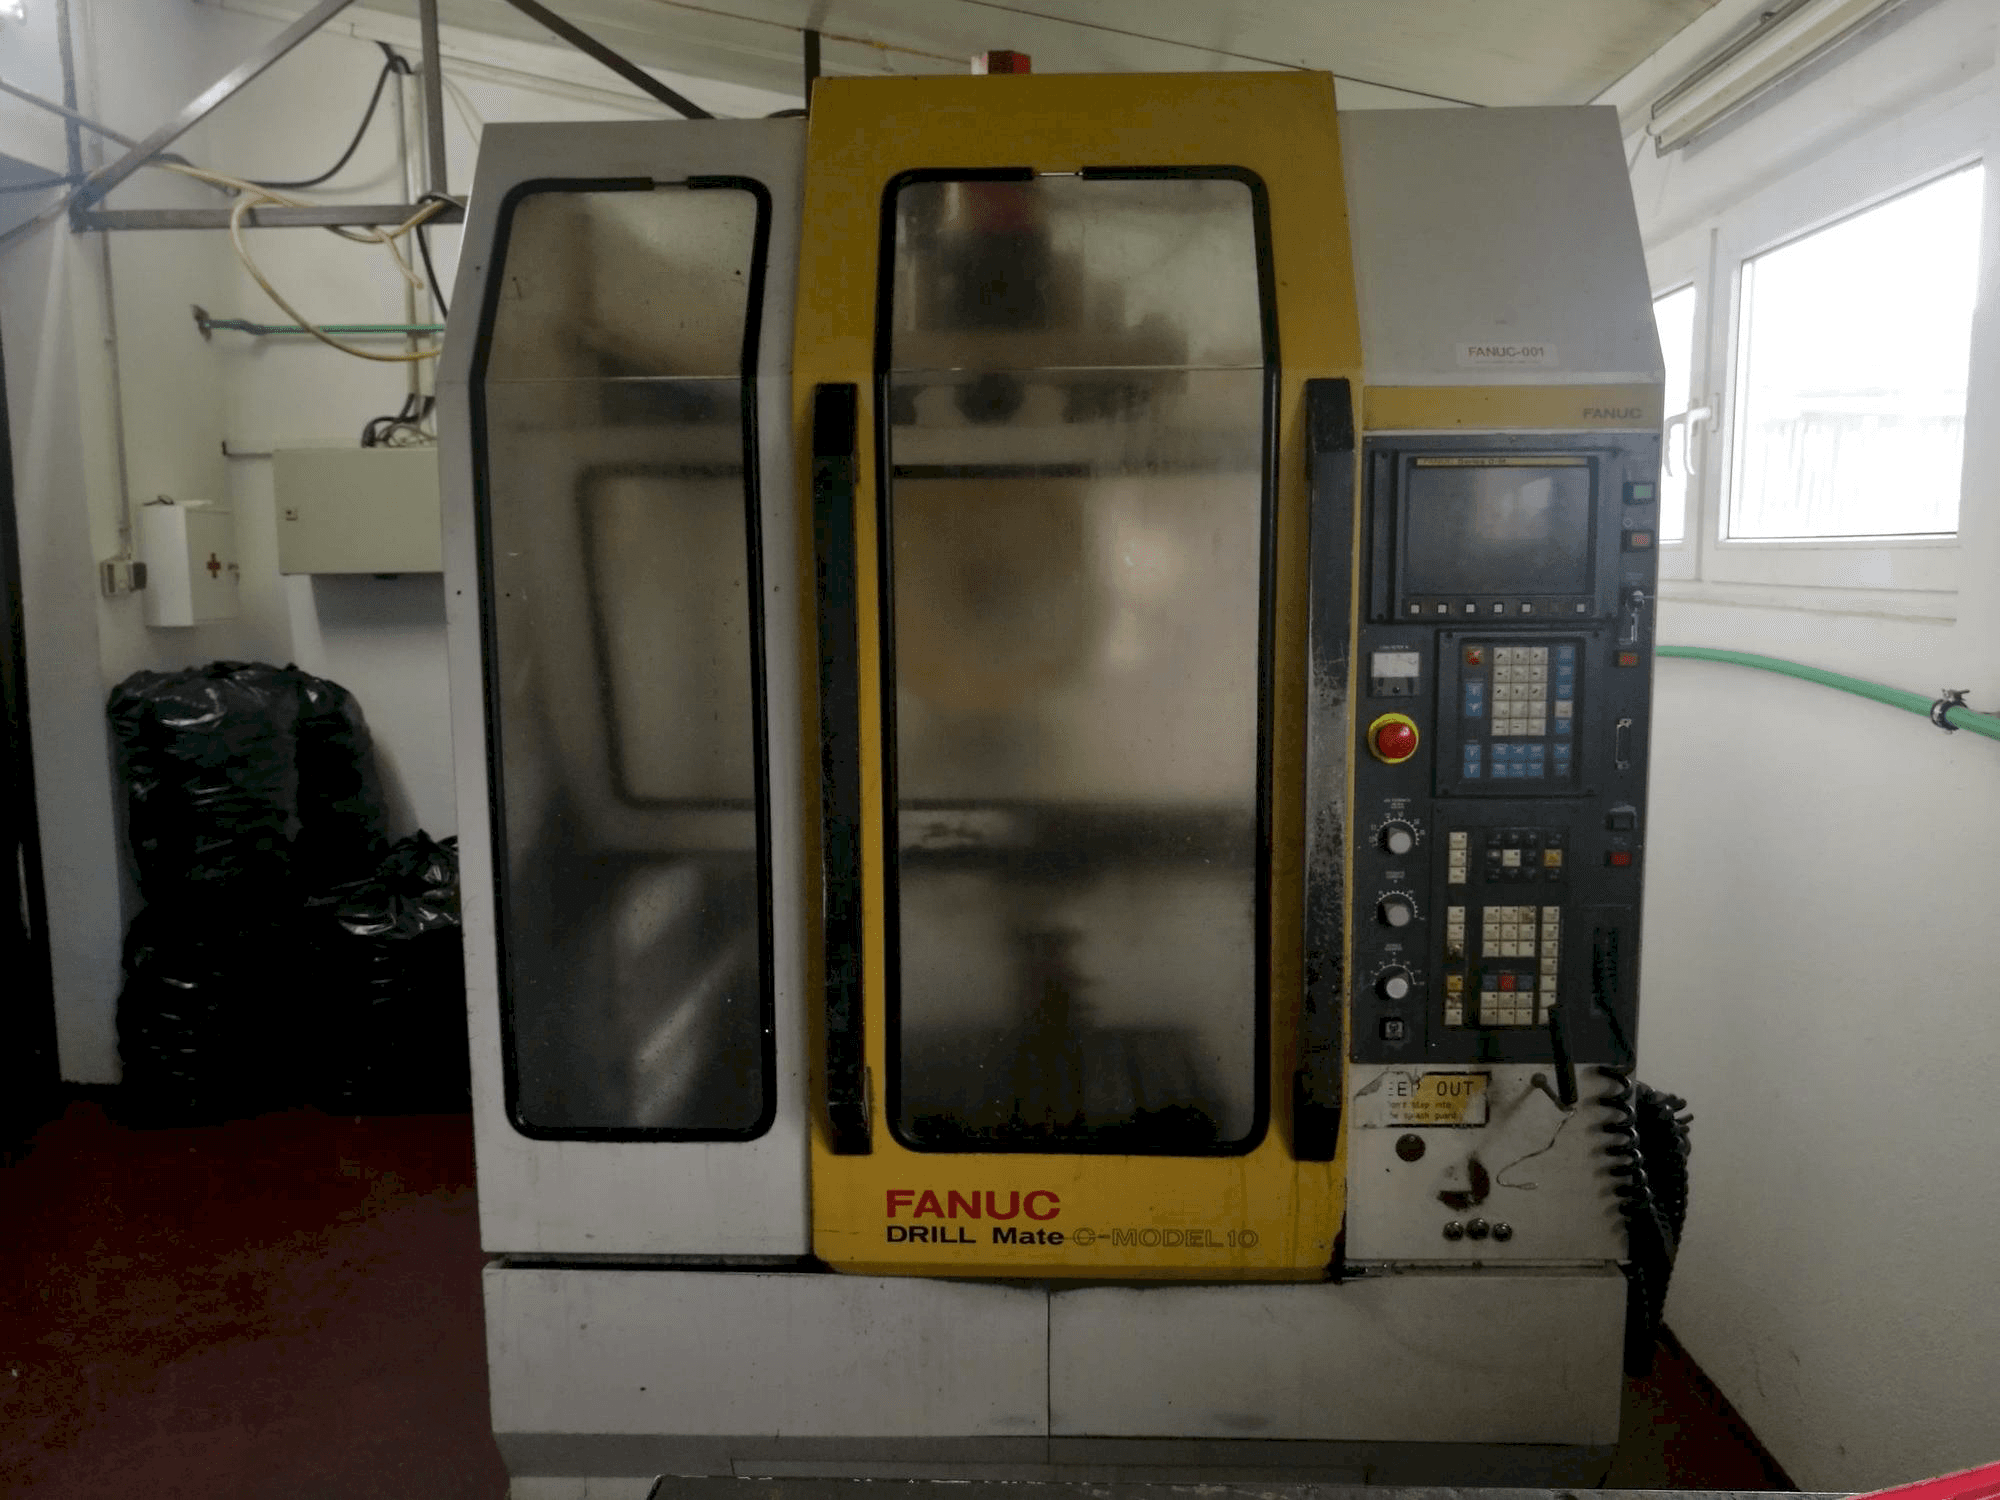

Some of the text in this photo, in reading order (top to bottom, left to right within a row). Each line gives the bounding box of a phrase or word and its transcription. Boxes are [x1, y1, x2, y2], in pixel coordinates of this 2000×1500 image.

[1467, 345, 1545, 358] FANUC-001
[1582, 407, 1643, 420] FANUC
[1436, 1080, 1475, 1097] OUT
[886, 1189, 1061, 1221] FANUC
[886, 1225, 977, 1244] DRILL
[992, 1226, 1065, 1245] Mate
